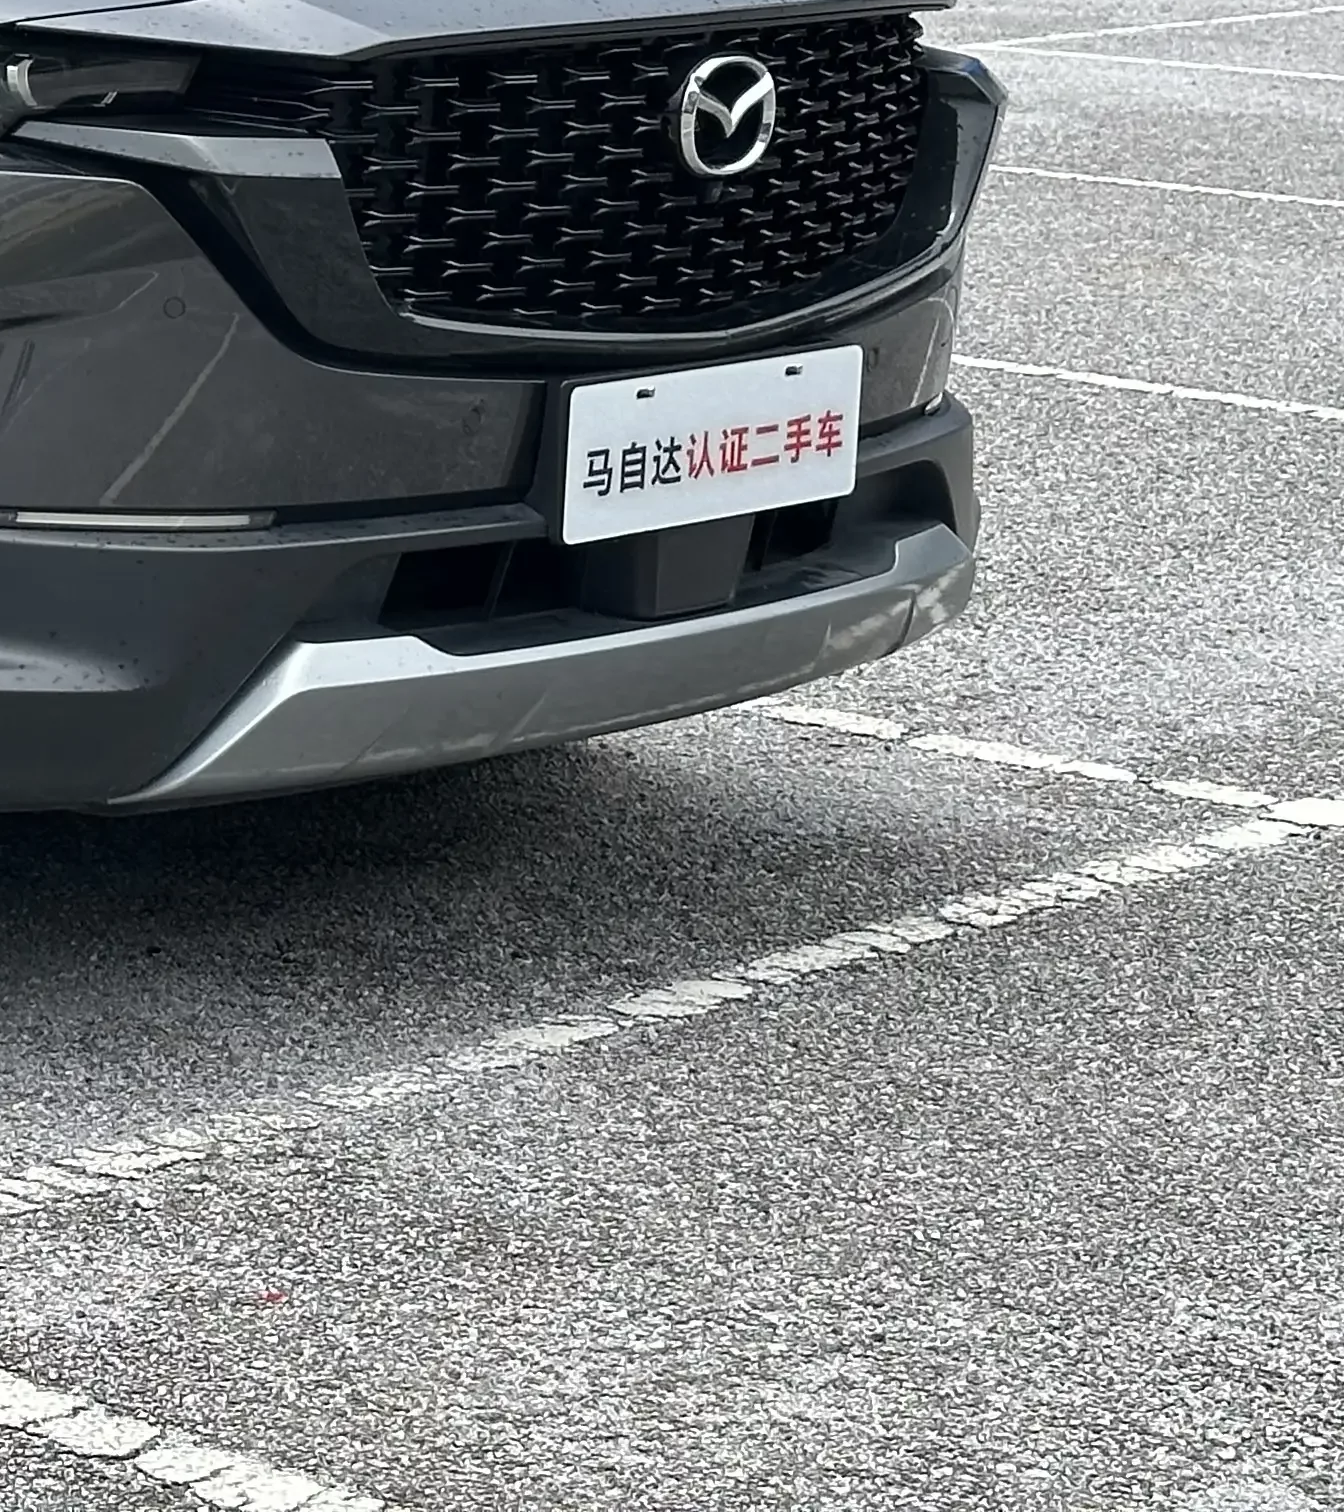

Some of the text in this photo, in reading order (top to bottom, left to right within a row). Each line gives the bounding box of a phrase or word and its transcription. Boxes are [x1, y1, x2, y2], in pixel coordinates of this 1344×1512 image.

[583, 410, 844, 496] 马自达认证二手车
